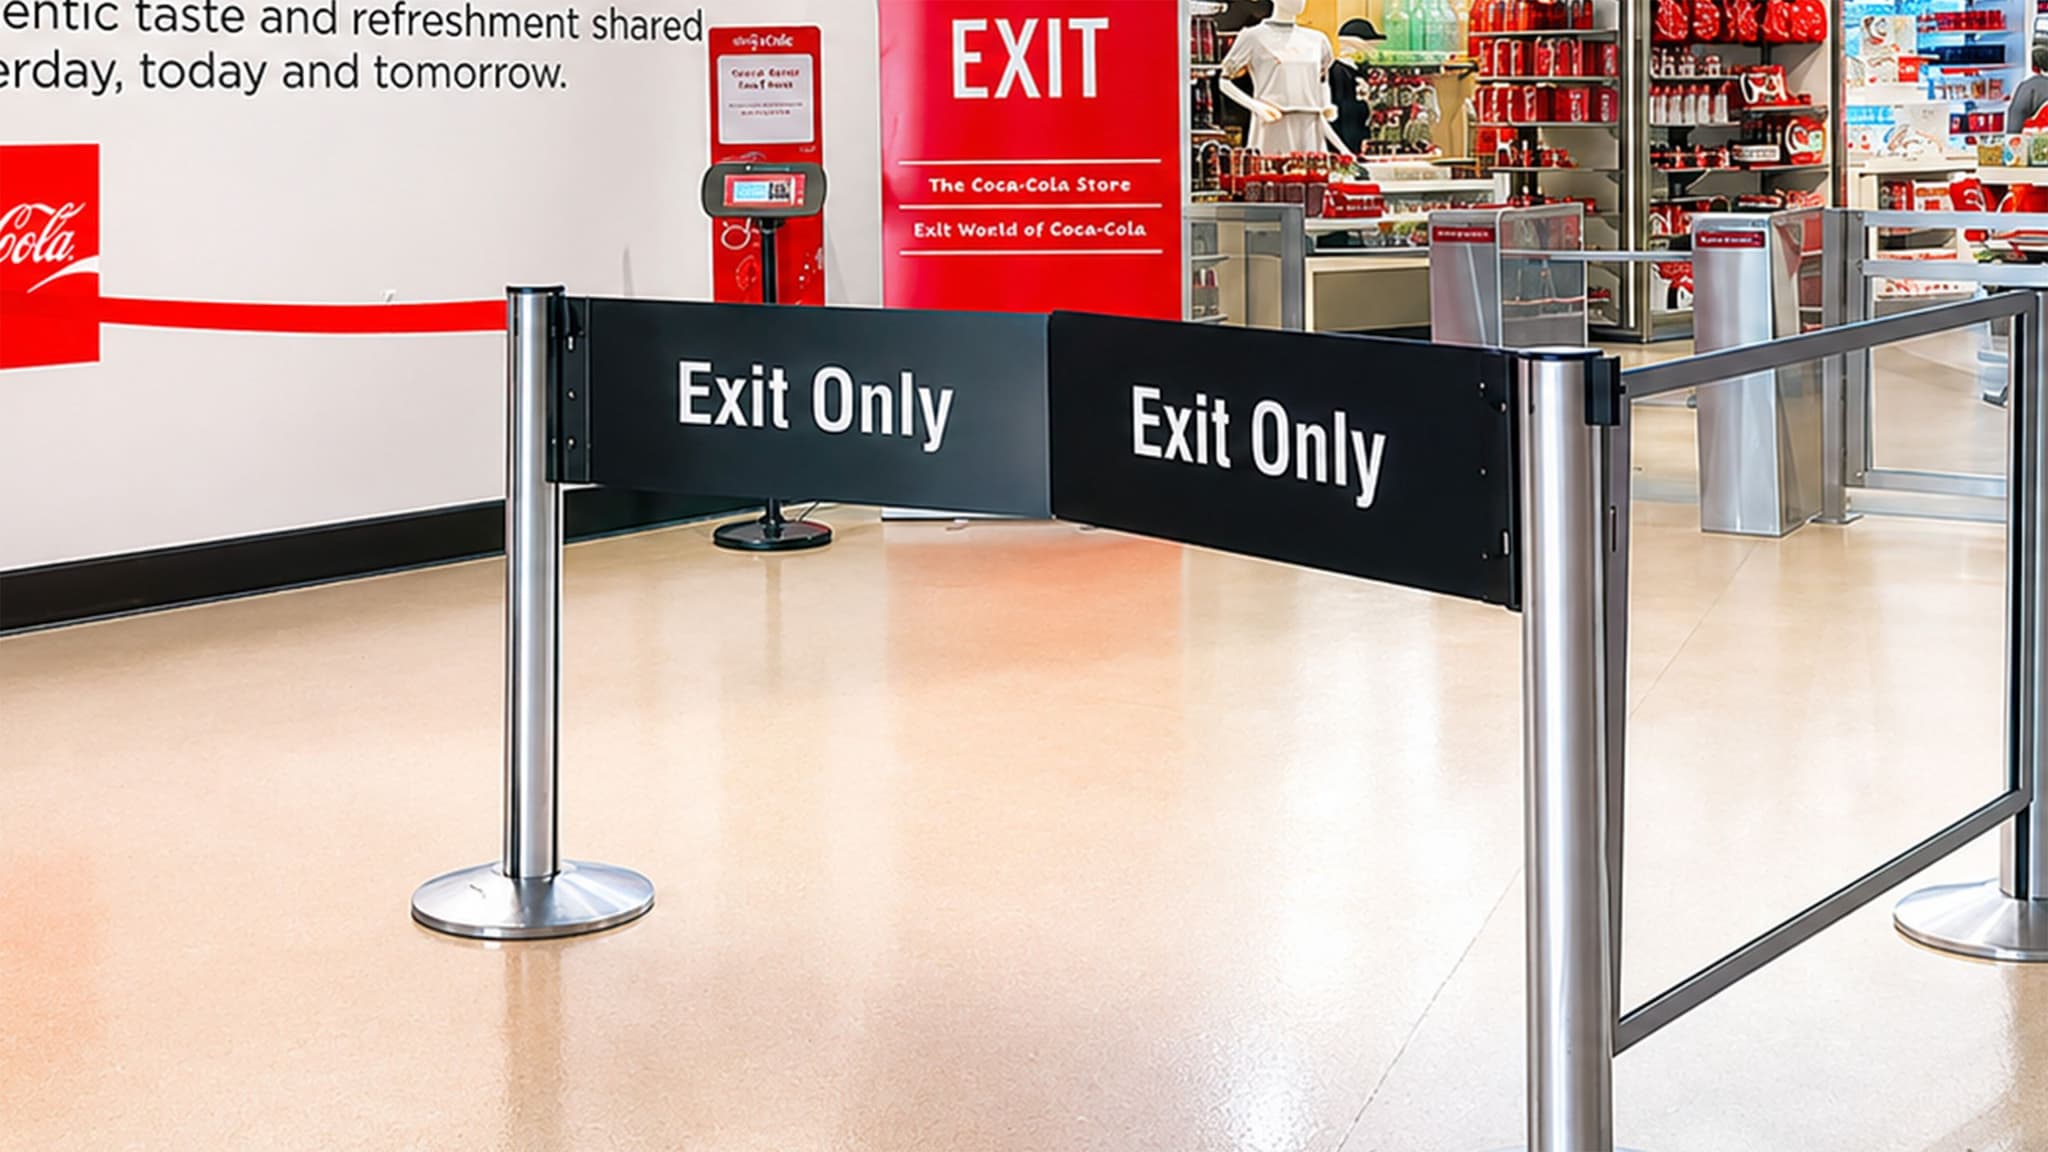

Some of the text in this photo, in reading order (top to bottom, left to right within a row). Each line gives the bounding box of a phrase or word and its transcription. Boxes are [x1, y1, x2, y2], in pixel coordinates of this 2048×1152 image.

[135, 0, 246, 34] taste
[260, 0, 338, 36] and
[353, 0, 581, 40] refreshment
[592, 8, 703, 43] shared
[139, 51, 268, 97] today
[282, 51, 359, 90] and
[373, 55, 567, 90] tomorrow.
[951, 17, 1109, 99] EXIT
[928, 176, 1131, 193] The Coca-Cola Store
[914, 220, 1147, 238] Exit World of Coca-Cola
[679, 361, 954, 453] Exit Only
[1133, 385, 1386, 508] Exit Only
